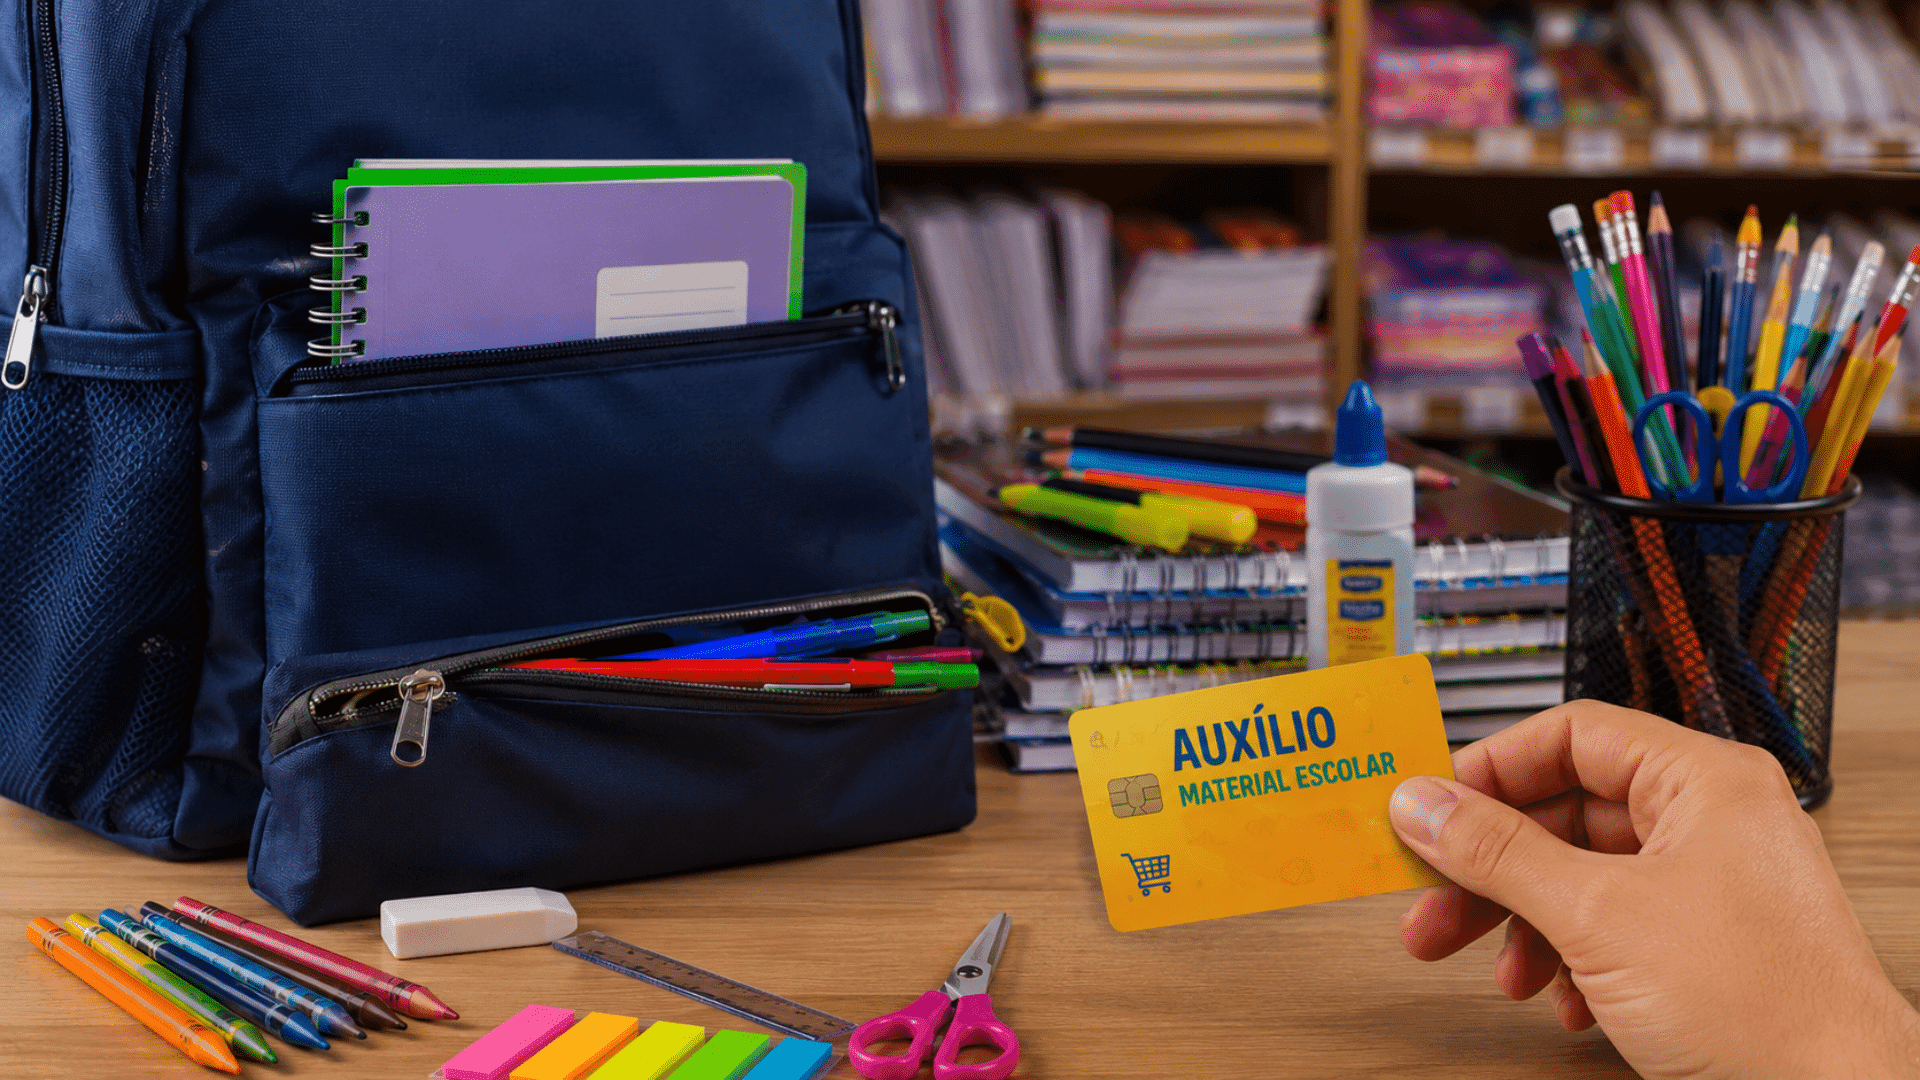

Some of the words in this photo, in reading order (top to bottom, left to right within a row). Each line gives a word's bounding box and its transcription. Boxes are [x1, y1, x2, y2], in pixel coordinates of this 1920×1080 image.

[1174, 704, 1336, 771] AUXÍLIO
[1178, 770, 1291, 807] MATERIAL
[1295, 752, 1397, 789] ESCOLAR
